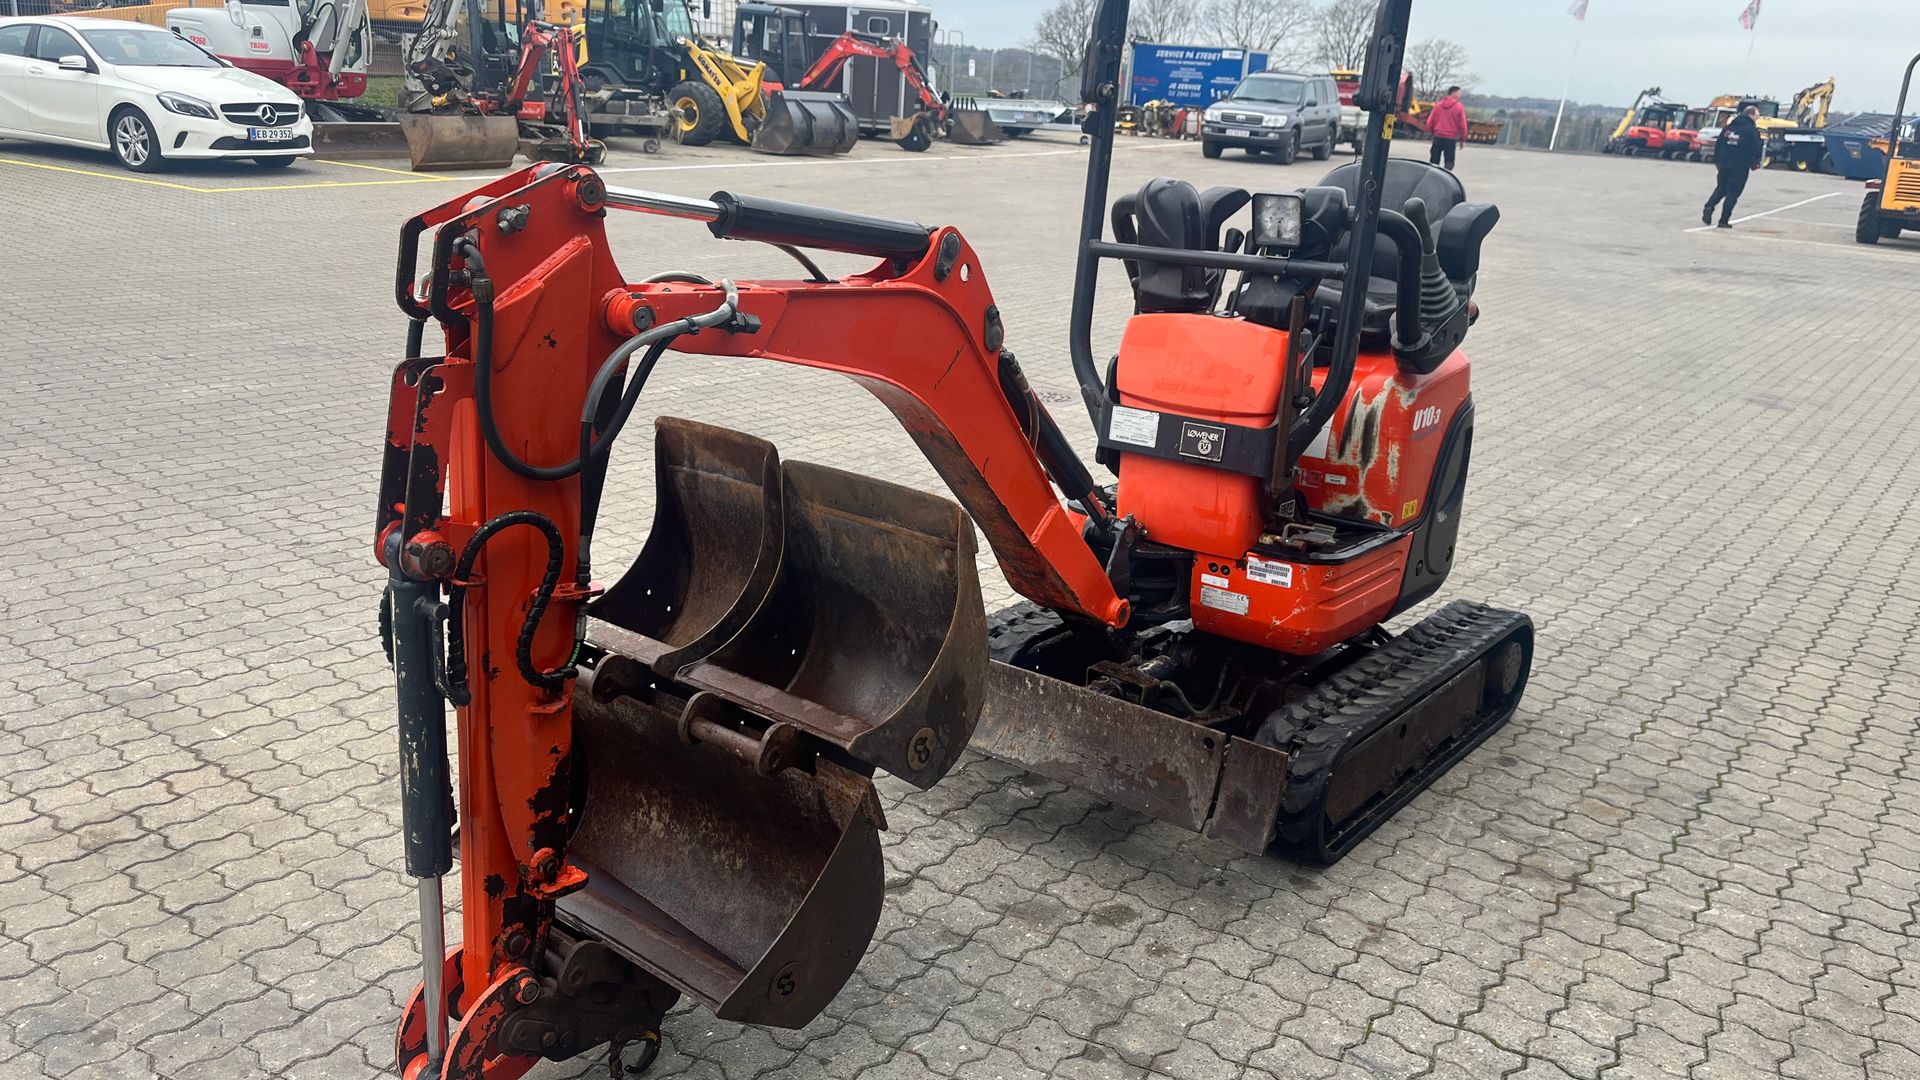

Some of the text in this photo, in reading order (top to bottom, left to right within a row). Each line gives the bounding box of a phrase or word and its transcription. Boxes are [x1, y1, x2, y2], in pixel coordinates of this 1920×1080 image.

[250, 42, 268, 50] TB260
[1155, 49, 1185, 60] SERVICE
[697, 54, 722, 86] KOMATSU
[1176, 83, 1202, 92] SERVICE
[256, 129, 292, 139] EB 29 352
[1412, 405, 1441, 432] U10-3
[1187, 428, 1219, 442] LØWENER
